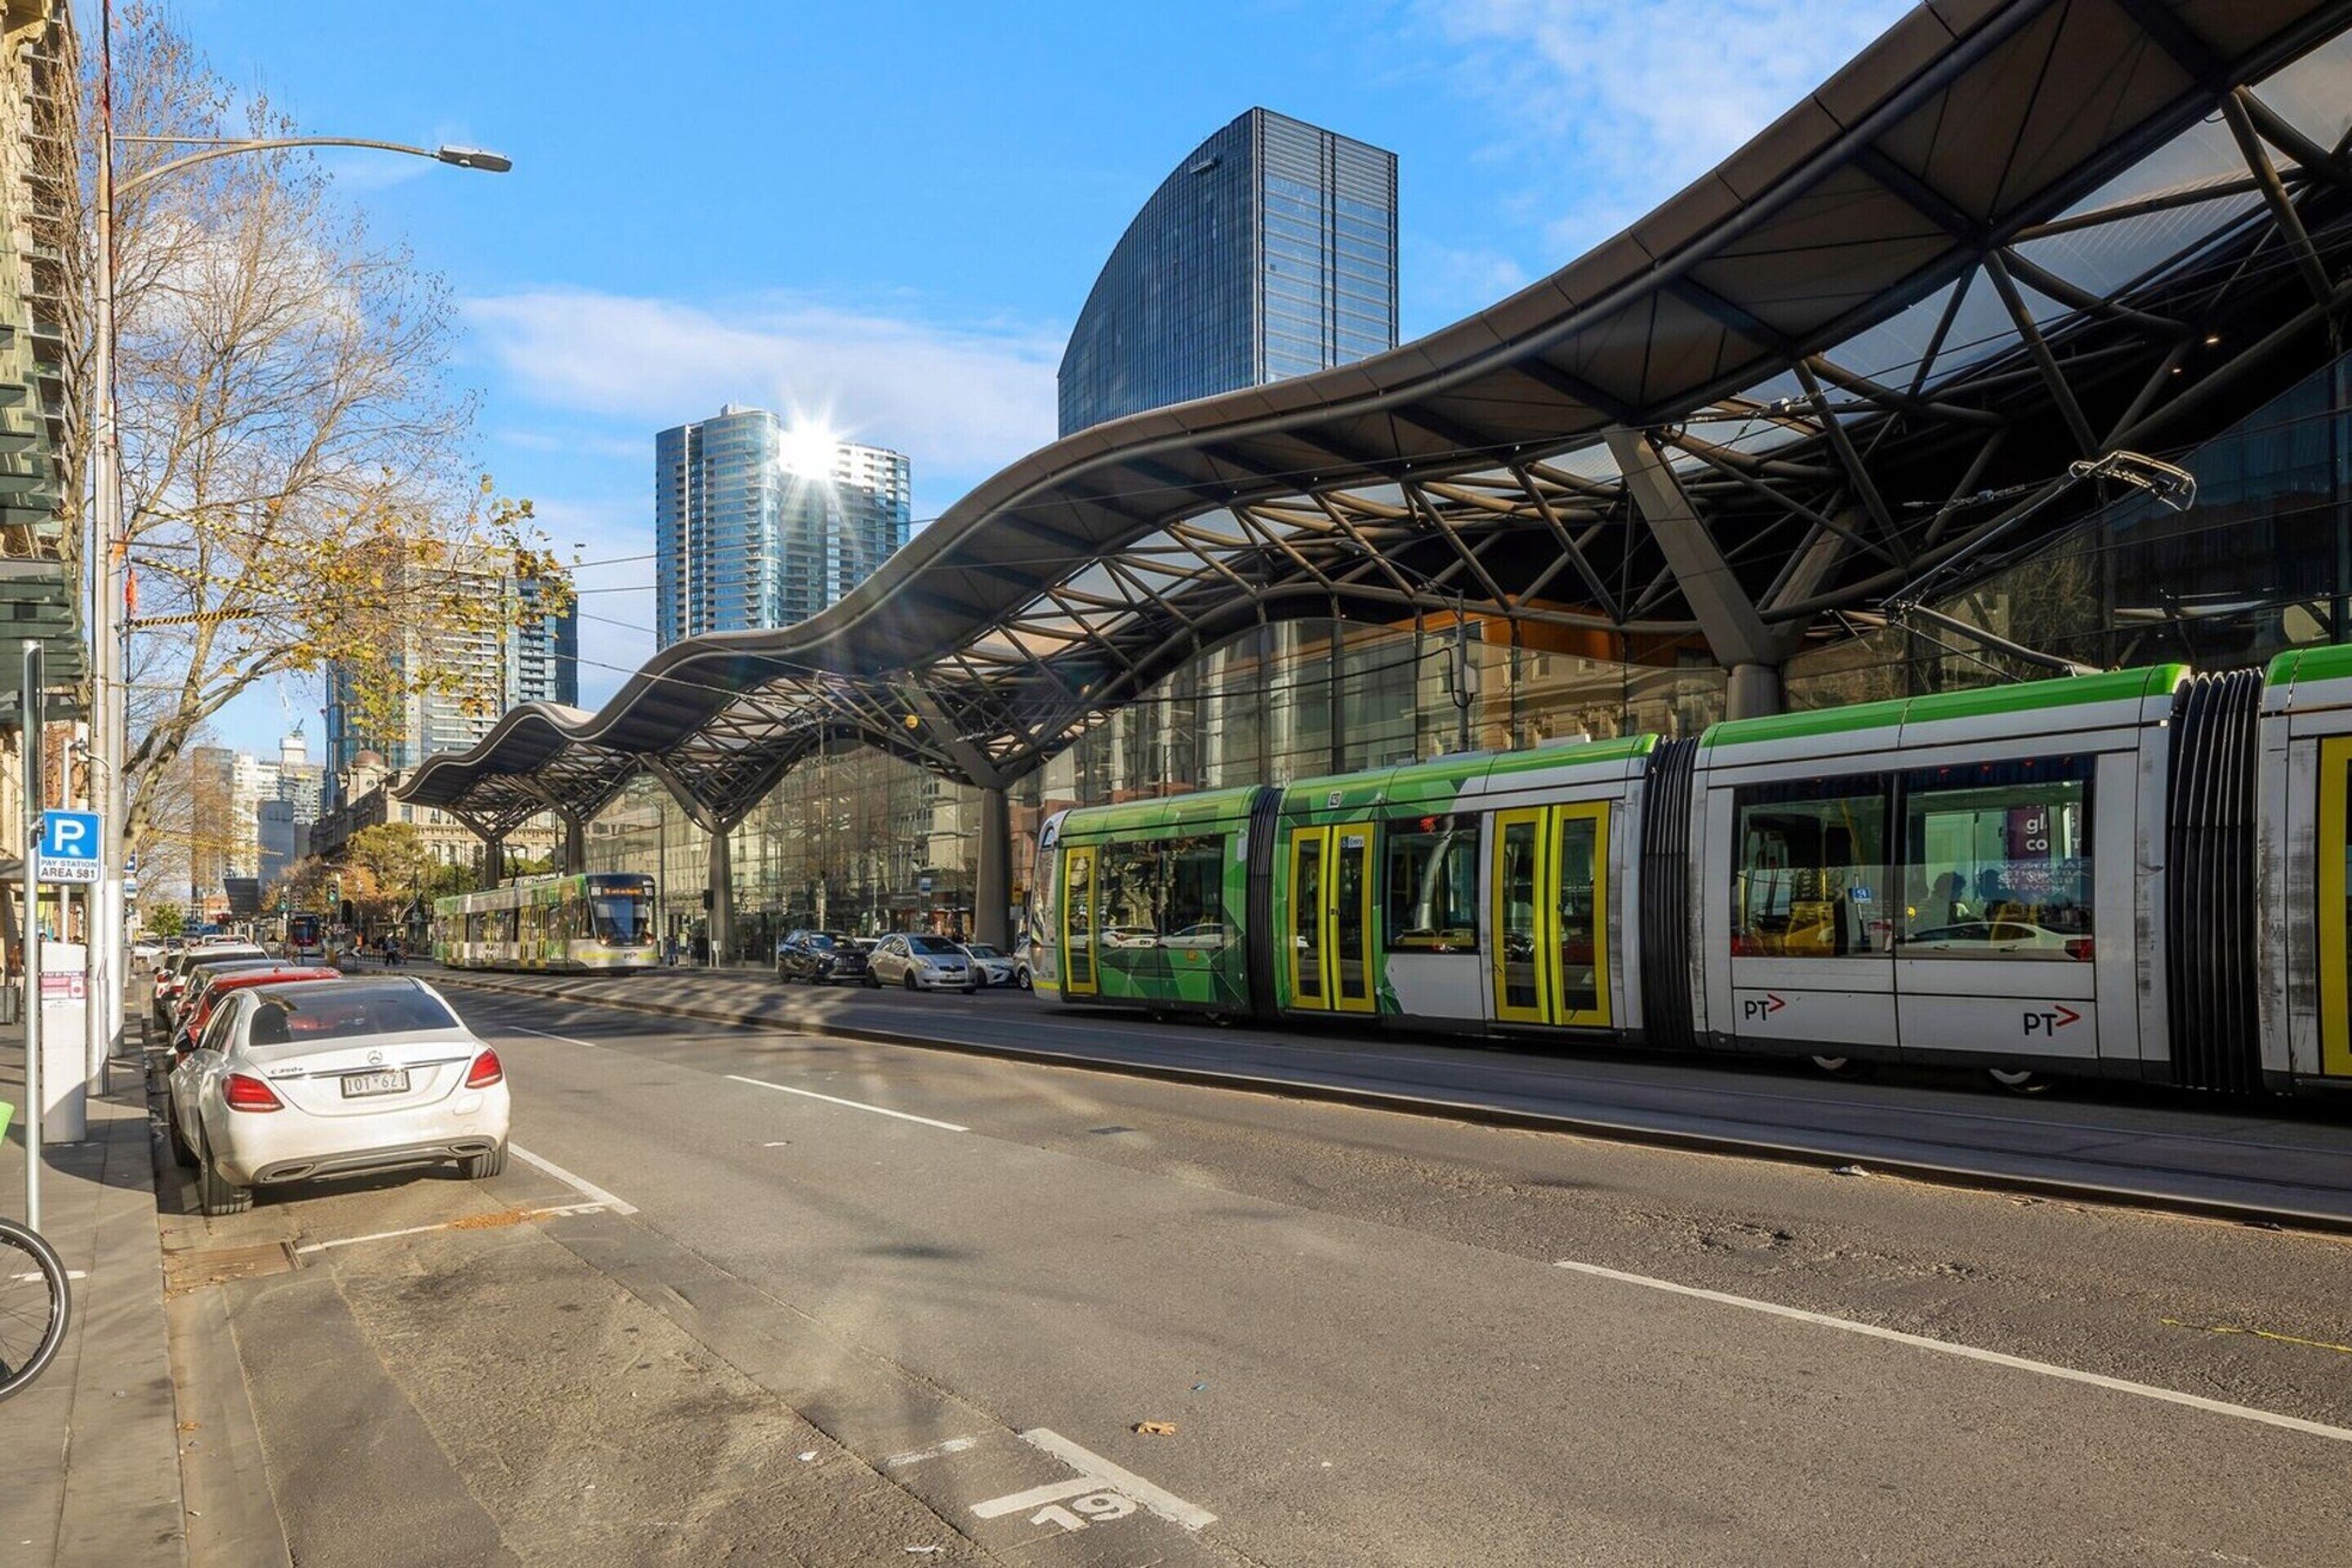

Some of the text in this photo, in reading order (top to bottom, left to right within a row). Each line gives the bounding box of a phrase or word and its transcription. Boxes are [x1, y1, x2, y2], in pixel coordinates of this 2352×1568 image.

[55, 819, 85, 851] P
[42, 867, 95, 879] AREA 581
